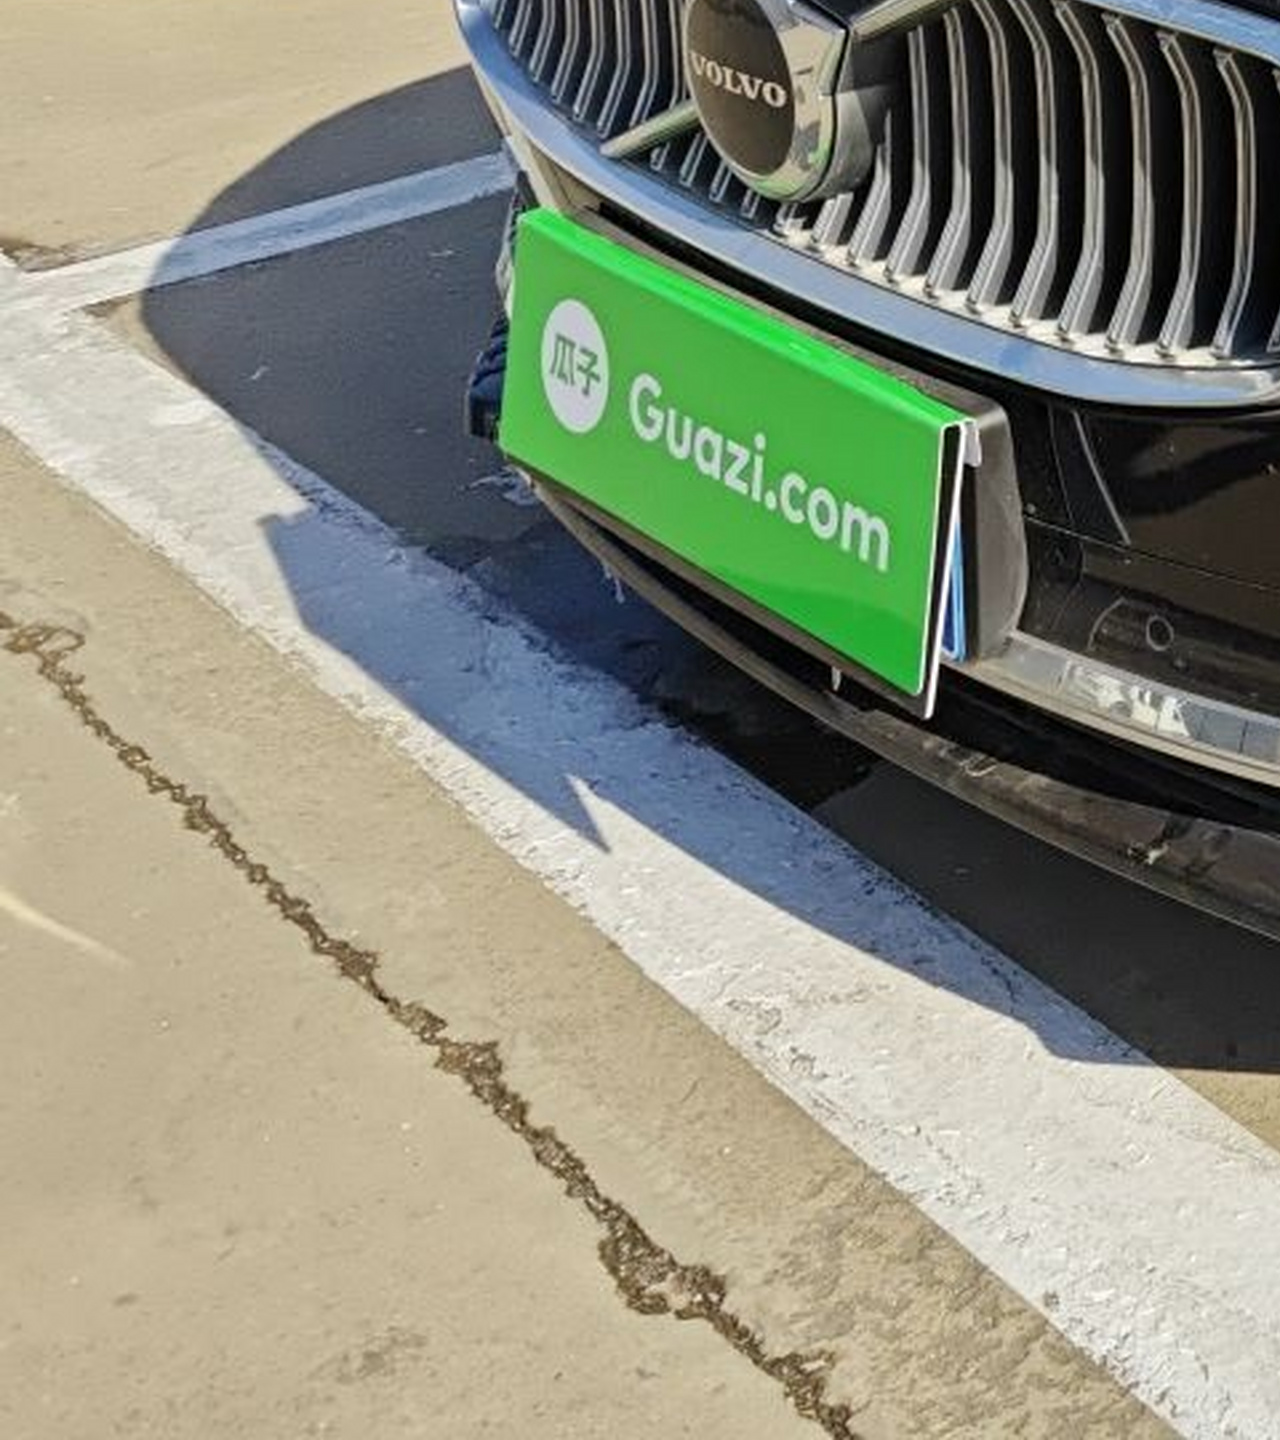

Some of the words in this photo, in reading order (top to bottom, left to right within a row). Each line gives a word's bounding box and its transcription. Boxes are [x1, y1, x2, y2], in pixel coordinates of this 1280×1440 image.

[689, 51, 787, 108] VOLVO
[550, 334, 600, 398] 瓜子
[628, 372, 892, 573] Guazi.com
